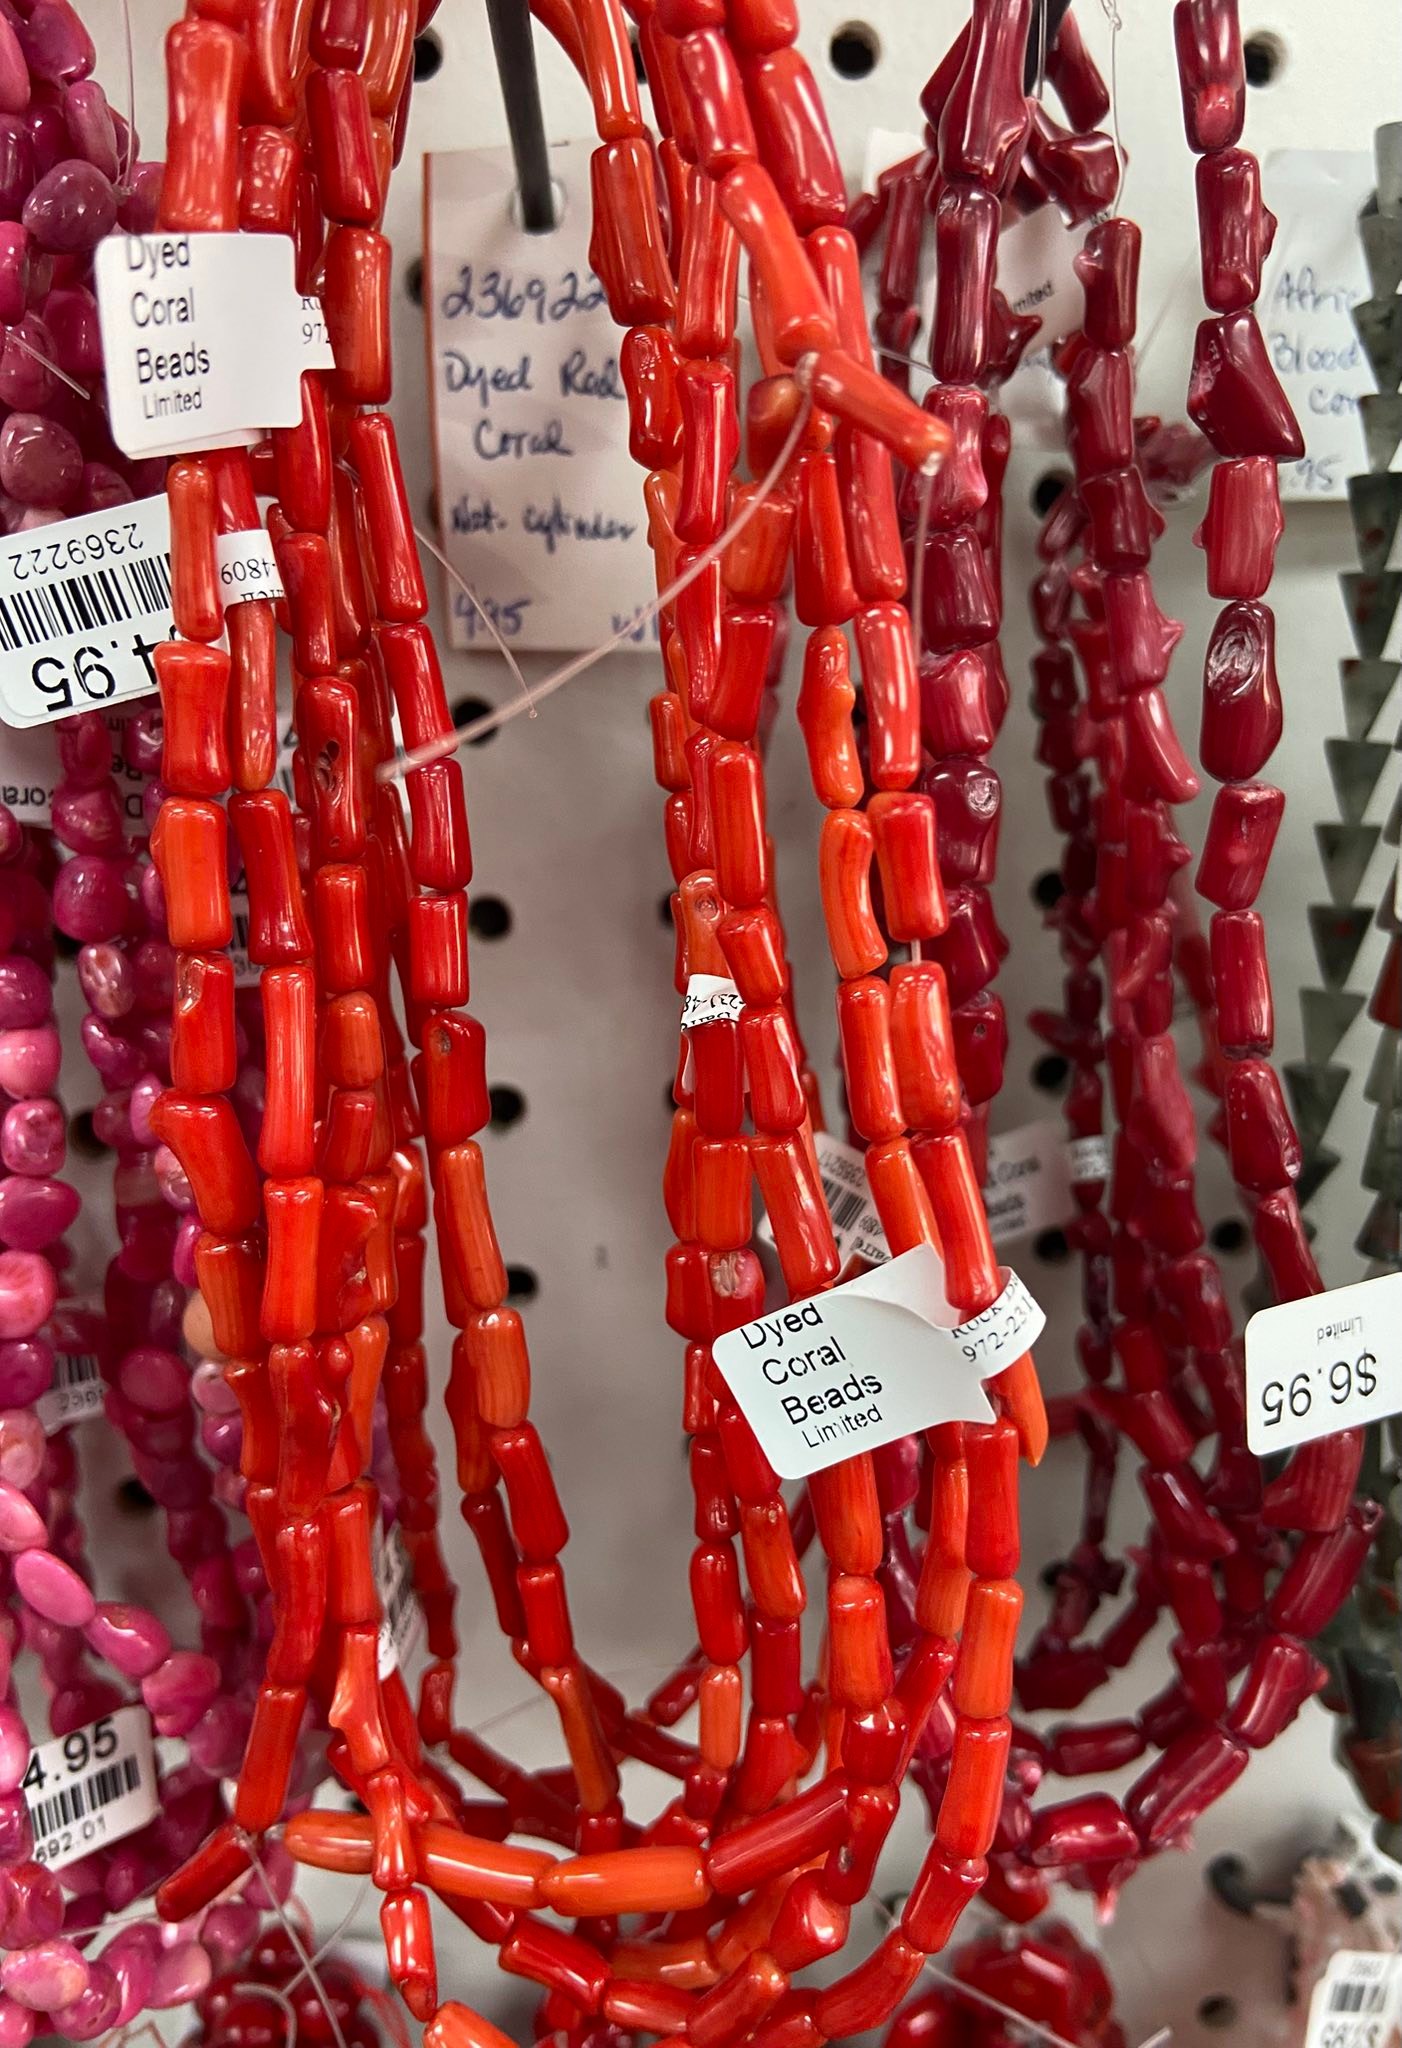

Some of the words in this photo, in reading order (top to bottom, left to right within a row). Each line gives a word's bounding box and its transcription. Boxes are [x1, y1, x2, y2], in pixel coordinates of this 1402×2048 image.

[127, 236, 190, 279] Dyed
[131, 287, 195, 328] Coral
[136, 341, 210, 384] Beads
[444, 350, 533, 408] Dyed
[142, 387, 202, 420] Limited
[474, 418, 573, 461] Coral
[8, 523, 143, 580] 2369222
[740, 1301, 824, 1350] Dyed
[1316, 1315, 1364, 1346] Limited
[762, 1335, 847, 1386] Coral
[780, 1373, 884, 1425] Beads
[1261, 1348, 1377, 1428] $6.95
[801, 1403, 884, 1449] Limited
